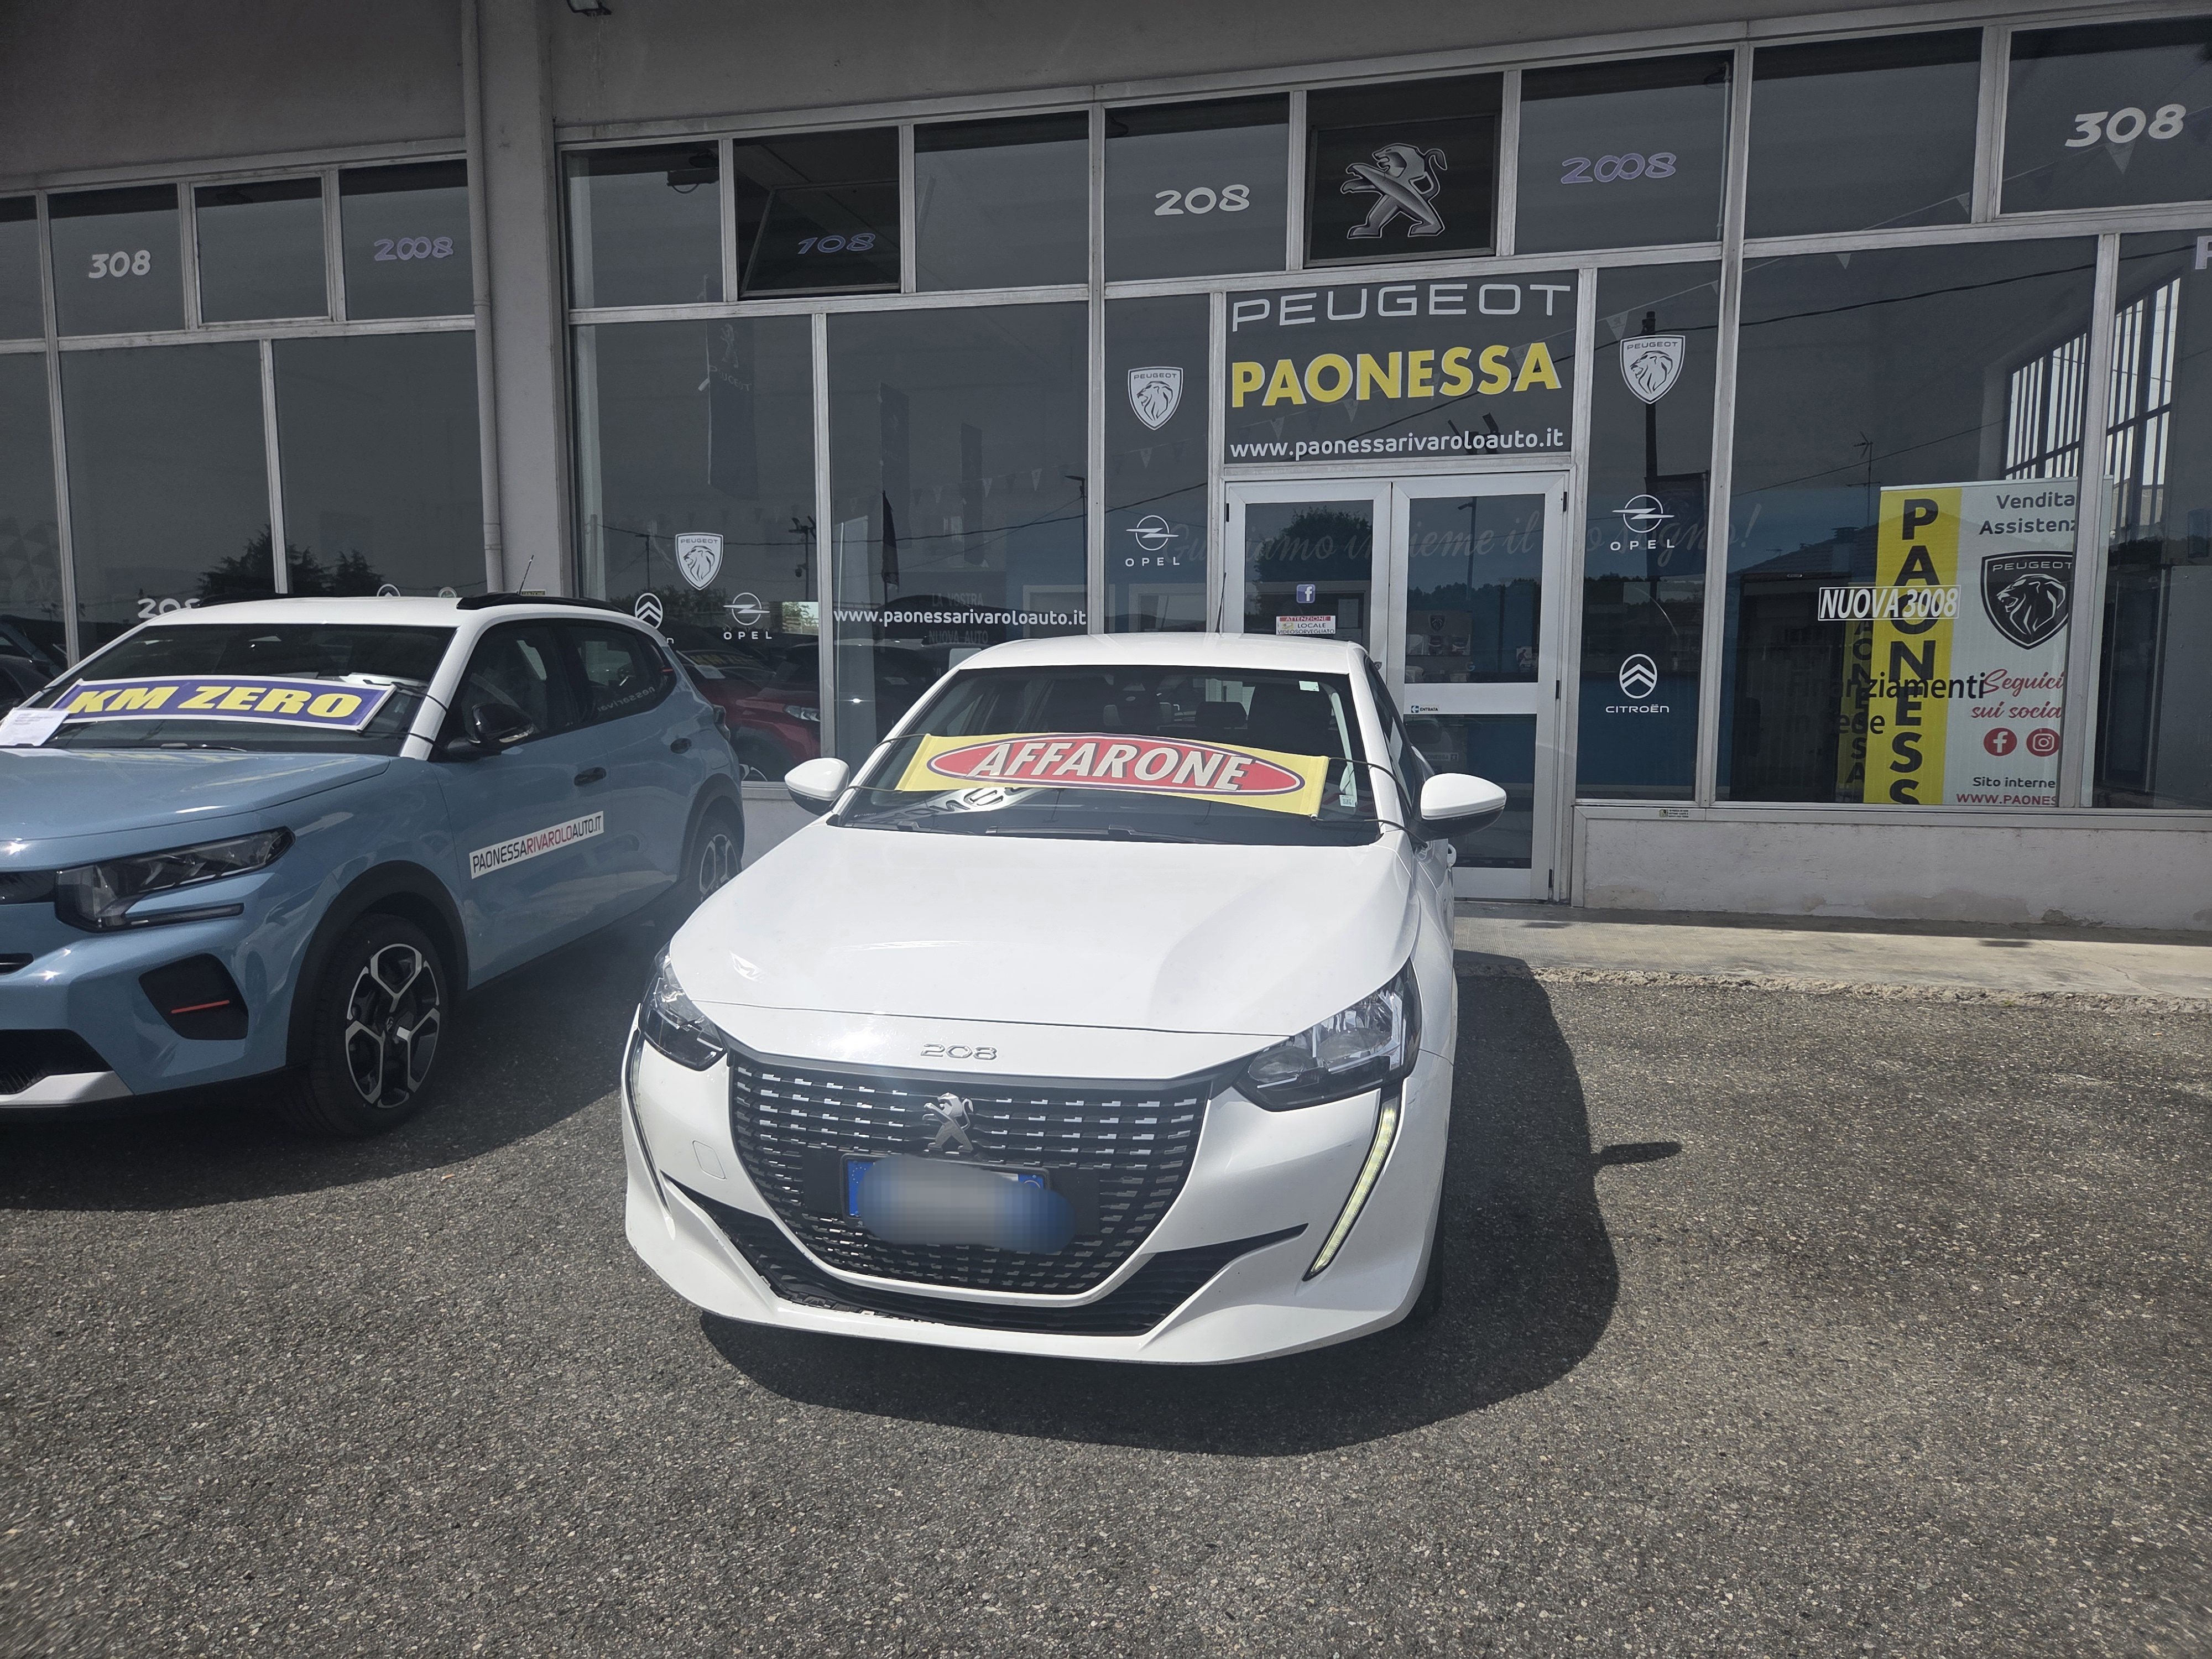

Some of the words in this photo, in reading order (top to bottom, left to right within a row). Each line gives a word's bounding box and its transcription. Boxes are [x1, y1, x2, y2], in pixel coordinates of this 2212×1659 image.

[2064, 104, 2187, 148] 308
[1561, 152, 1677, 184] 2008
[1154, 184, 1250, 216] 208
[374, 237, 454, 261] 2008
[797, 233, 877, 255] 108
[88, 250, 151, 279] 308
[1233, 284, 1571, 332] PEUGEOT
[1627, 341, 1678, 350] PEUGEOT
[1232, 342, 1562, 408] PAONESSA
[1230, 428, 1564, 461] www.paonessarivaroloauto.it
[1996, 492, 2075, 509] Vendita
[1610, 539, 1675, 551] OPEL
[1125, 556, 1180, 567] OPEL
[1992, 561, 2073, 572] PEUGEOT
[1820, 589, 1899, 618] NUOVA
[1901, 587, 1958, 618] 3008
[834, 608, 1087, 627] www.paonessarivaroloauto.it
[723, 630, 772, 640] OPEL
[68, 686, 173, 714] KM
[178, 686, 362, 718] ZERO
[967, 740, 1255, 792] AFFARONE
[1973, 776, 2001, 787] Sito
[473, 815, 602, 874] PAONESSARIVAROLOAUTO.IT
[920, 1042, 998, 1061] 208
